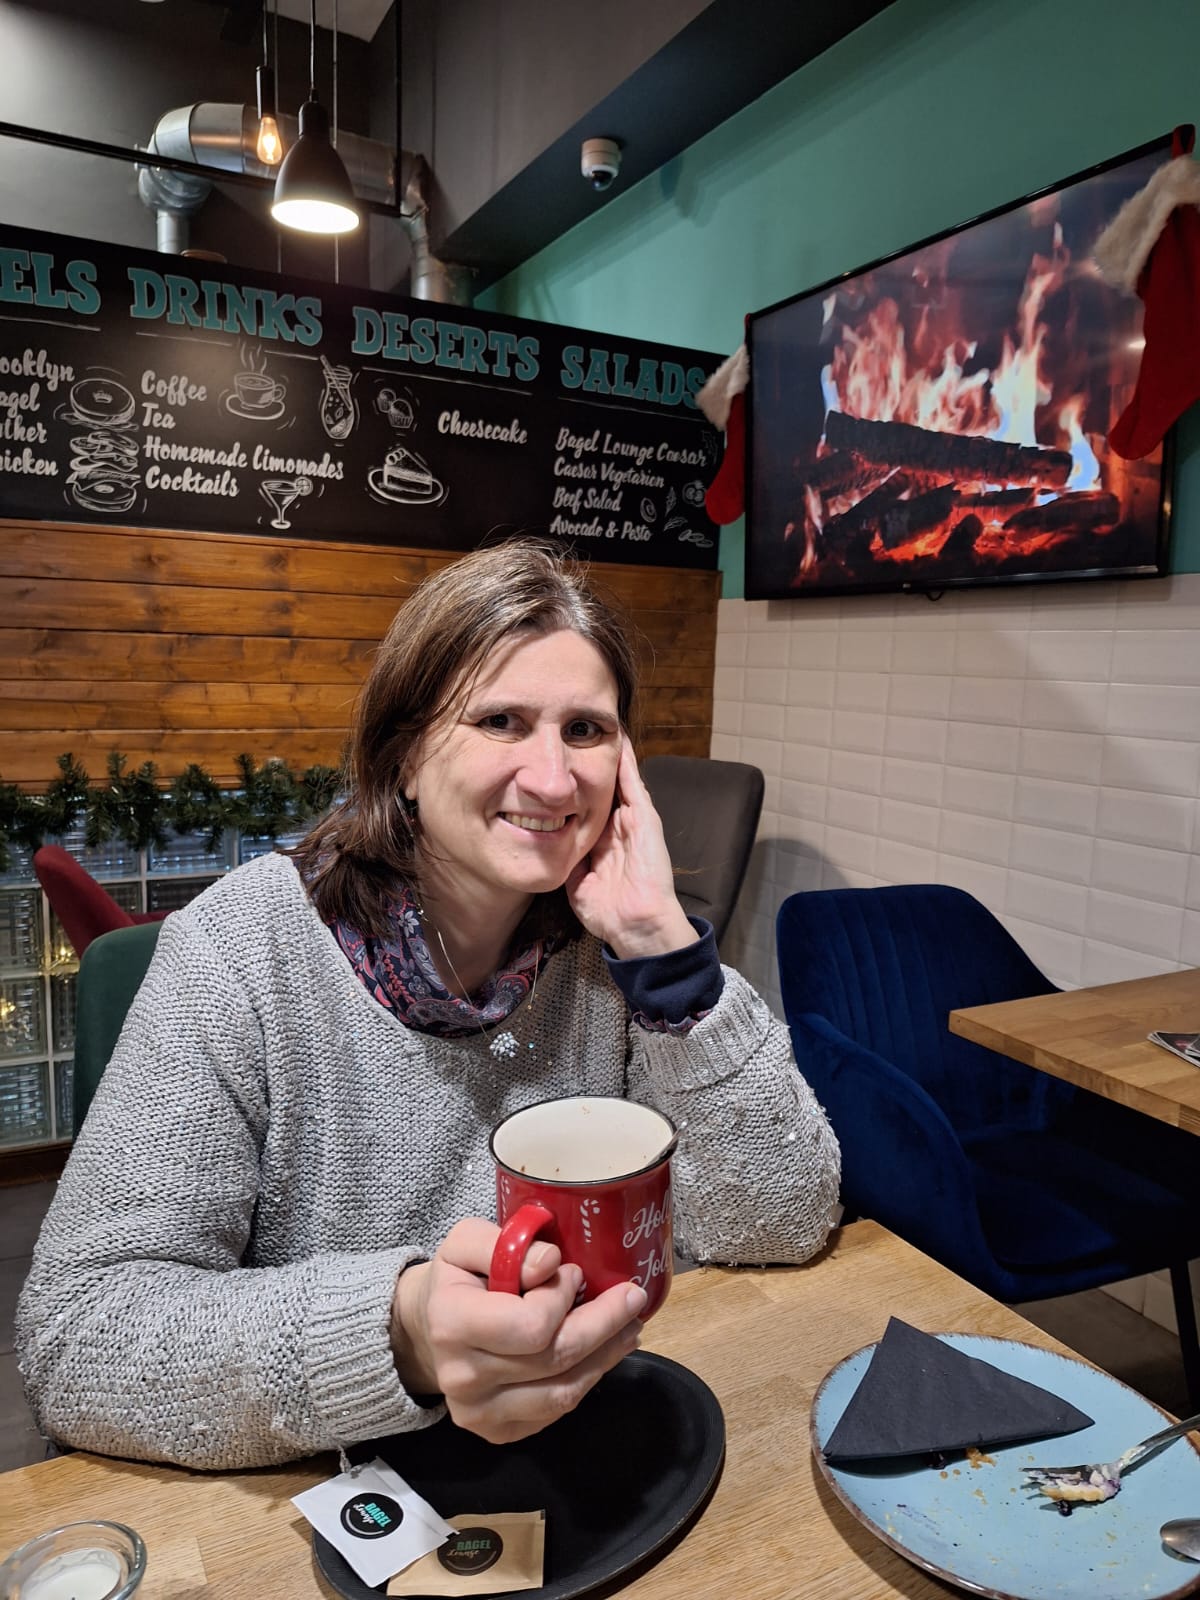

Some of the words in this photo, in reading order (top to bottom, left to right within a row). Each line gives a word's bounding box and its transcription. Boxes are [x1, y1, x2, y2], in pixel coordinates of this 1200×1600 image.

[128, 267, 322, 346] DRINKS
[352, 306, 540, 382] DESERTS
[141, 370, 207, 407] Coffee
[560, 345, 706, 410] SALADS
[142, 402, 176, 430] Tea
[437, 410, 528, 445] Cheesecake
[143, 435, 248, 468] Homemade
[555, 427, 600, 459] Bagel
[602, 433, 654, 466] Lounge
[656, 442, 707, 467] Caesar
[145, 465, 240, 497] Cocktails
[553, 456, 598, 479] Caesar
[552, 486, 583, 515] Beef
[584, 487, 623, 512] Salad
[550, 514, 602, 537] Avocado
[605, 521, 619, 538] &
[620, 521, 653, 541] Pesto
[364, 1502, 392, 1527] BAGEL
[456, 1539, 491, 1551] BAGEL
